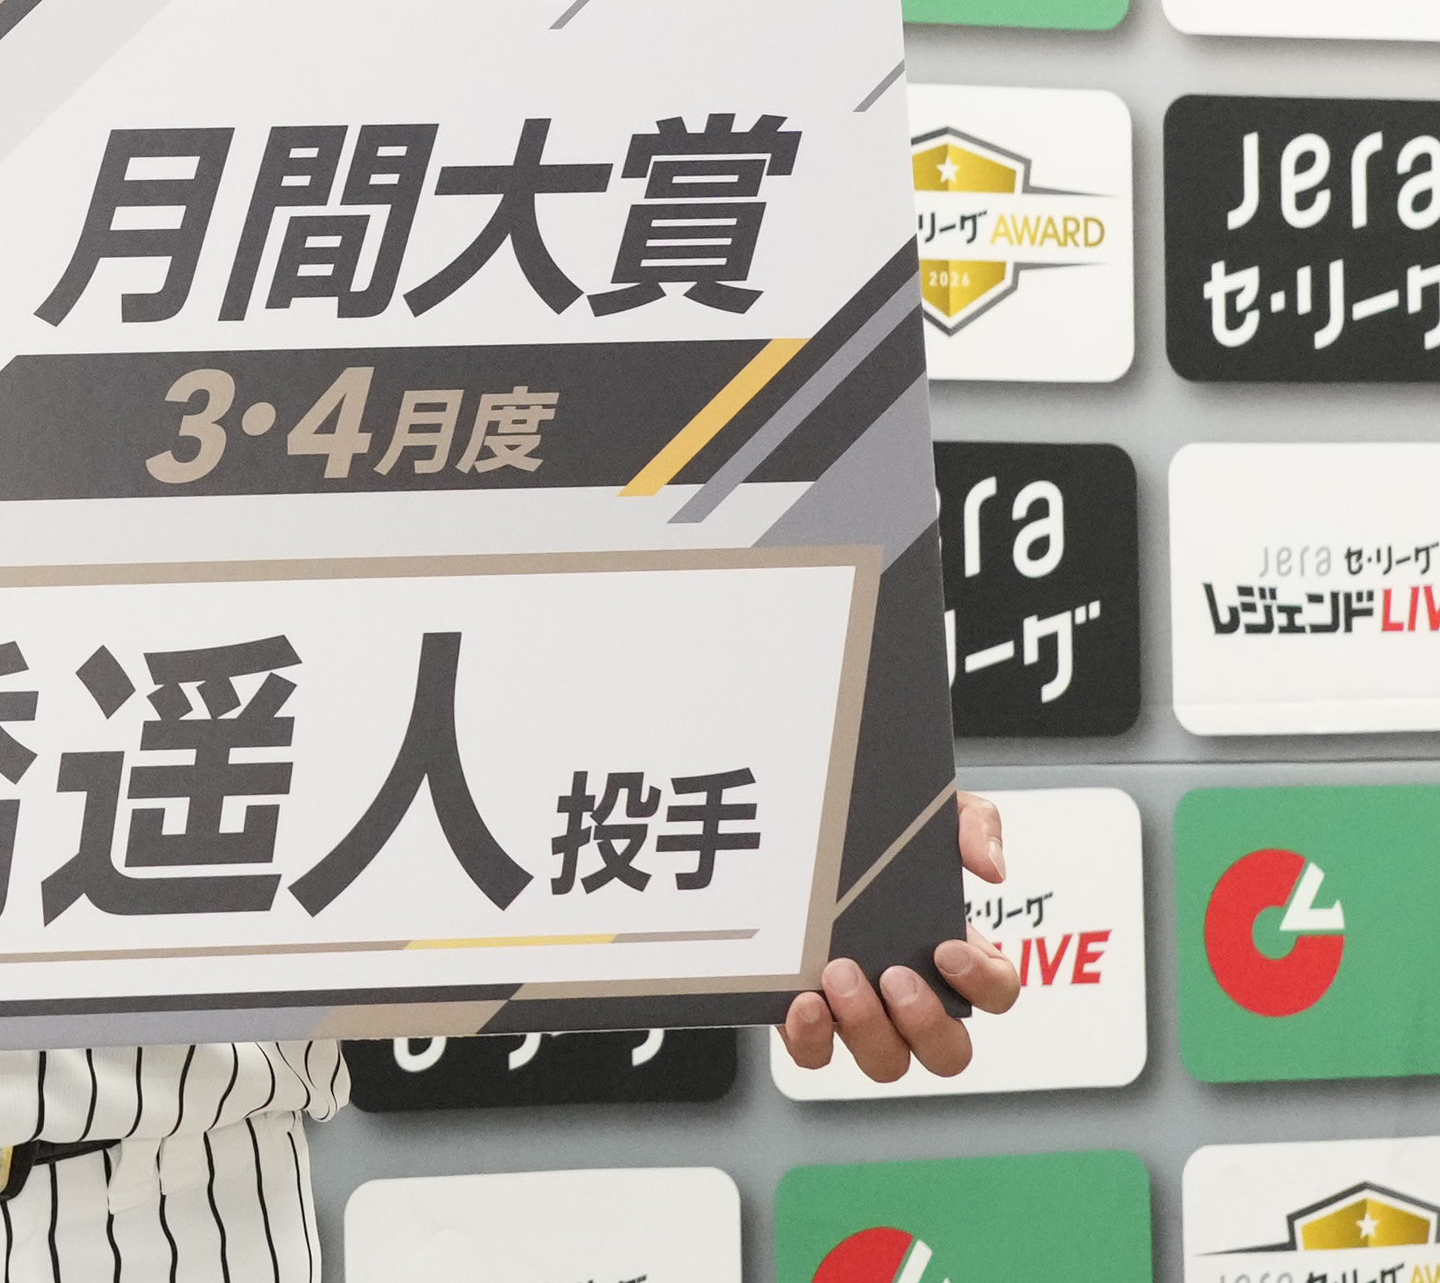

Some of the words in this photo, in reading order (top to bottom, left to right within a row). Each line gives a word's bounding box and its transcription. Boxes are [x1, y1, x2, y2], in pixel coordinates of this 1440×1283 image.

[33, 112, 802, 327] 月間大賞
[918, 210, 987, 244] リーグ
[990, 213, 1105, 248] AWARD
[928, 271, 971, 287] 2026
[1345, 542, 1440, 576] セ・リーグ
[1203, 582, 1440, 634] レジェンドLI
[550, 767, 761, 895] 投手
